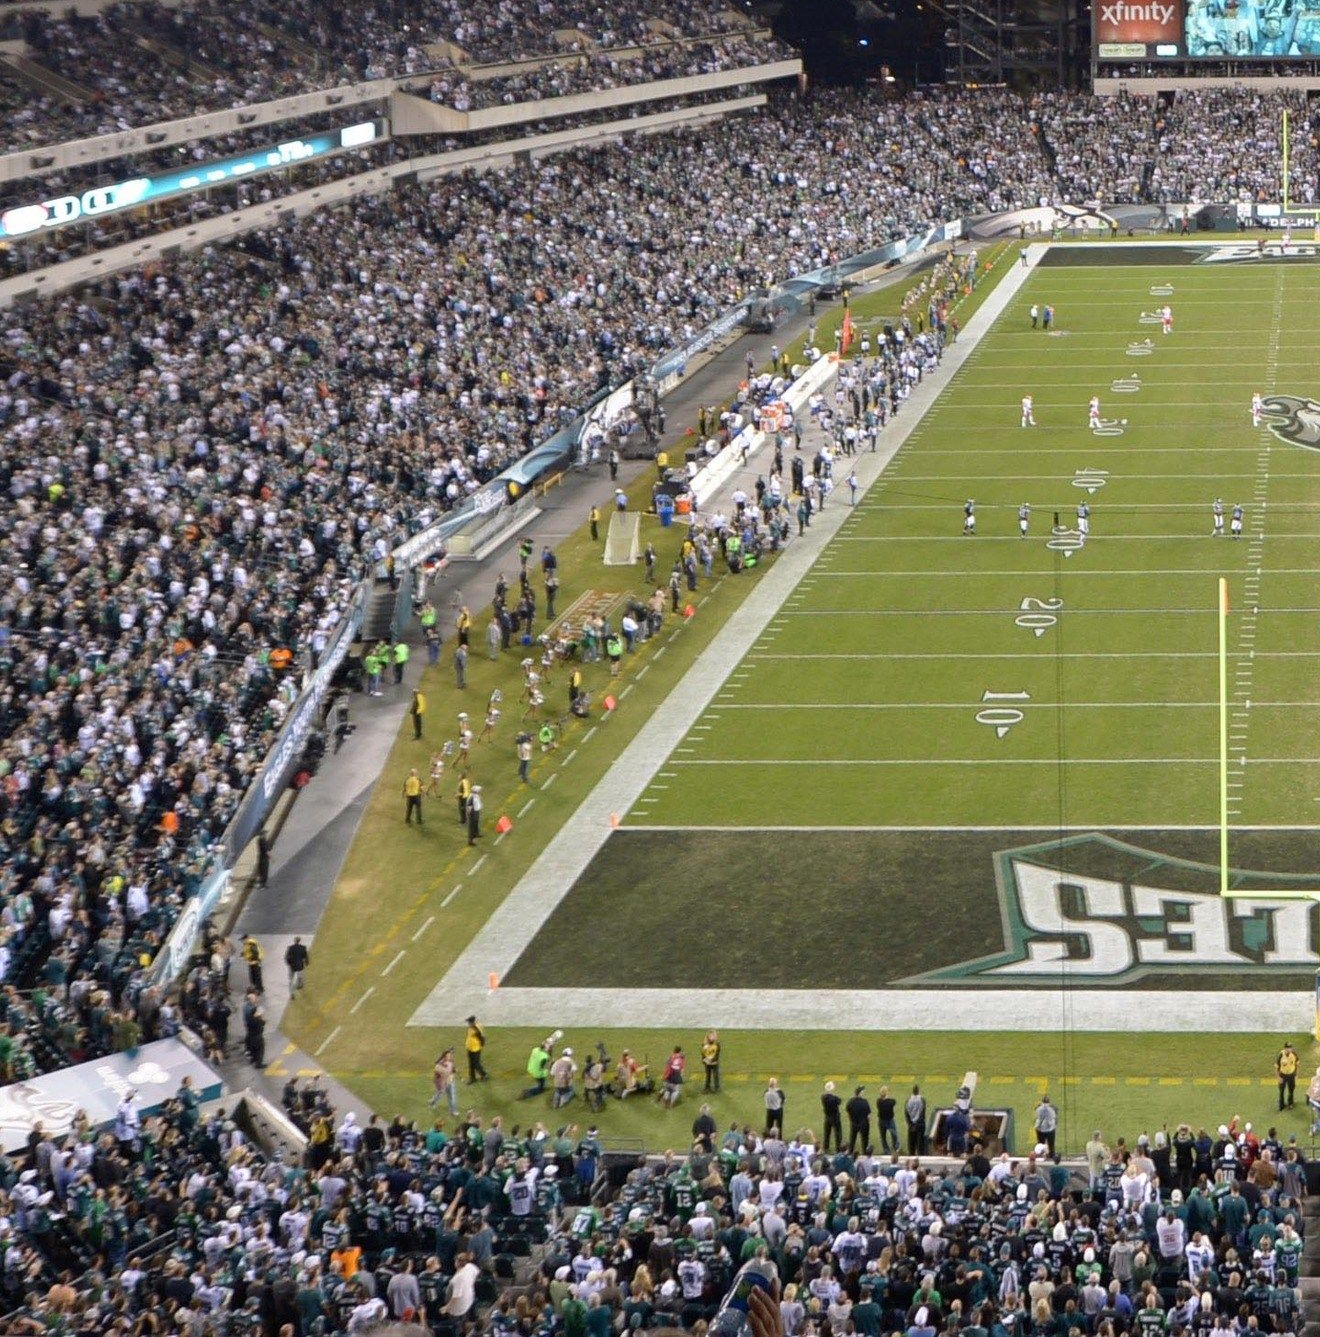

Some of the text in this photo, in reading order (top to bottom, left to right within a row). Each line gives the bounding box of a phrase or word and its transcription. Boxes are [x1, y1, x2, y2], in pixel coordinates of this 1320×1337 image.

[1102, 0, 1175, 26] xfinity
[1071, 467, 1110, 487] 40
[1046, 525, 1084, 549] 30
[1015, 597, 1064, 627] 20
[975, 690, 1031, 724] 10
